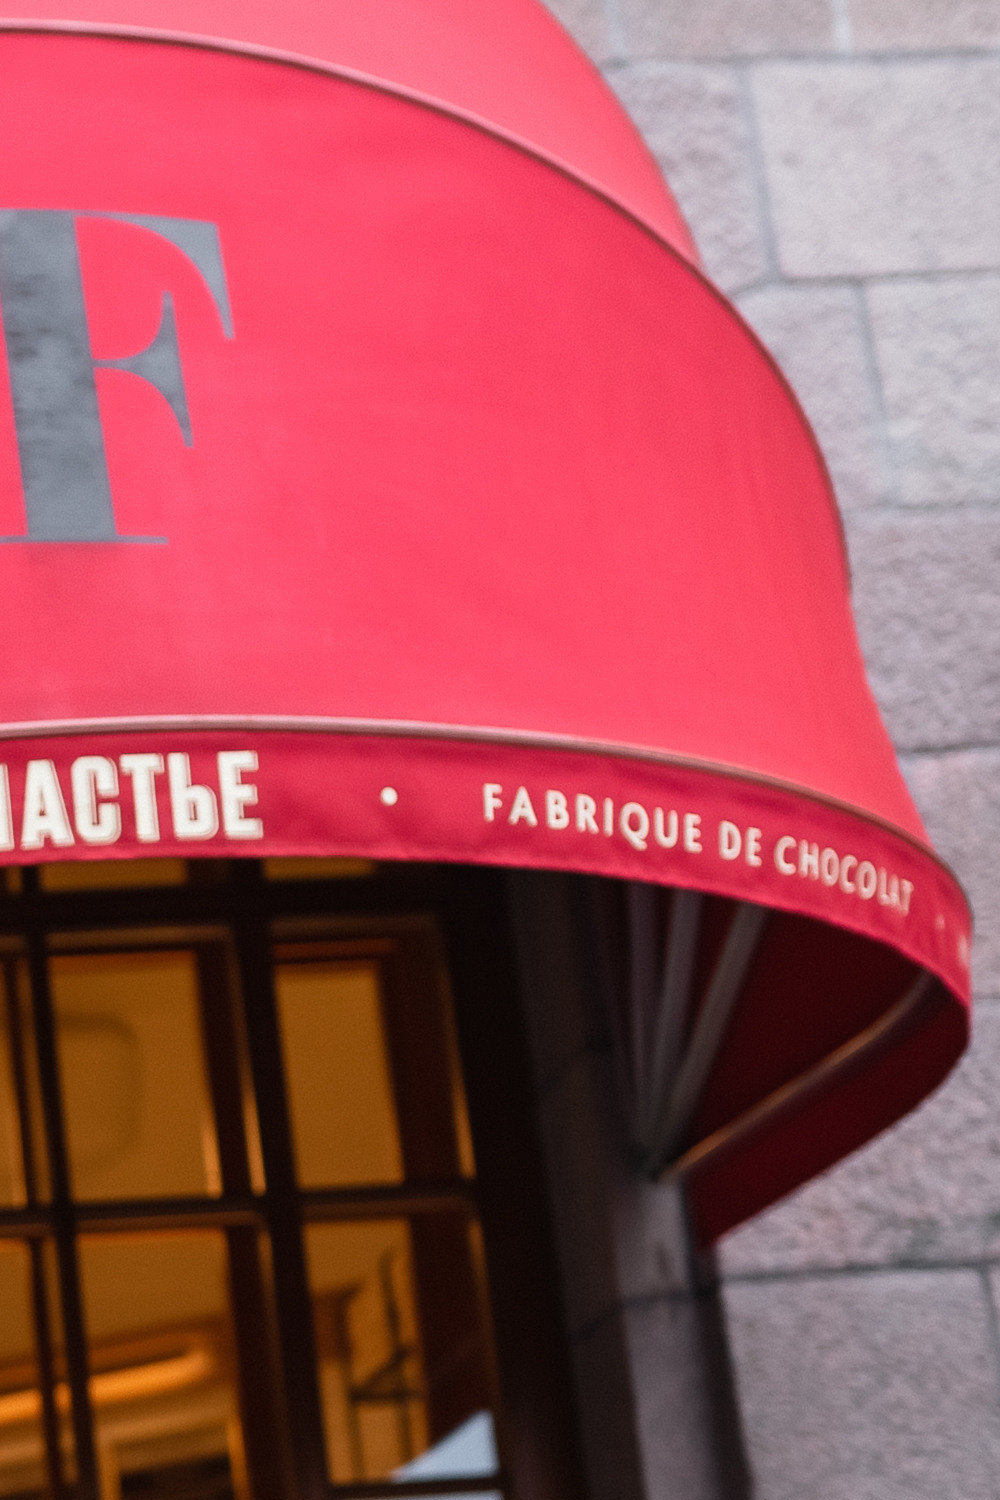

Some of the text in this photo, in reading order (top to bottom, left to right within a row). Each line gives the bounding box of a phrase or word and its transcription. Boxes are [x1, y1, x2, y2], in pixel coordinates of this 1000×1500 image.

[482, 782, 915, 918] FABRIQUE DE CHOCOLAT
